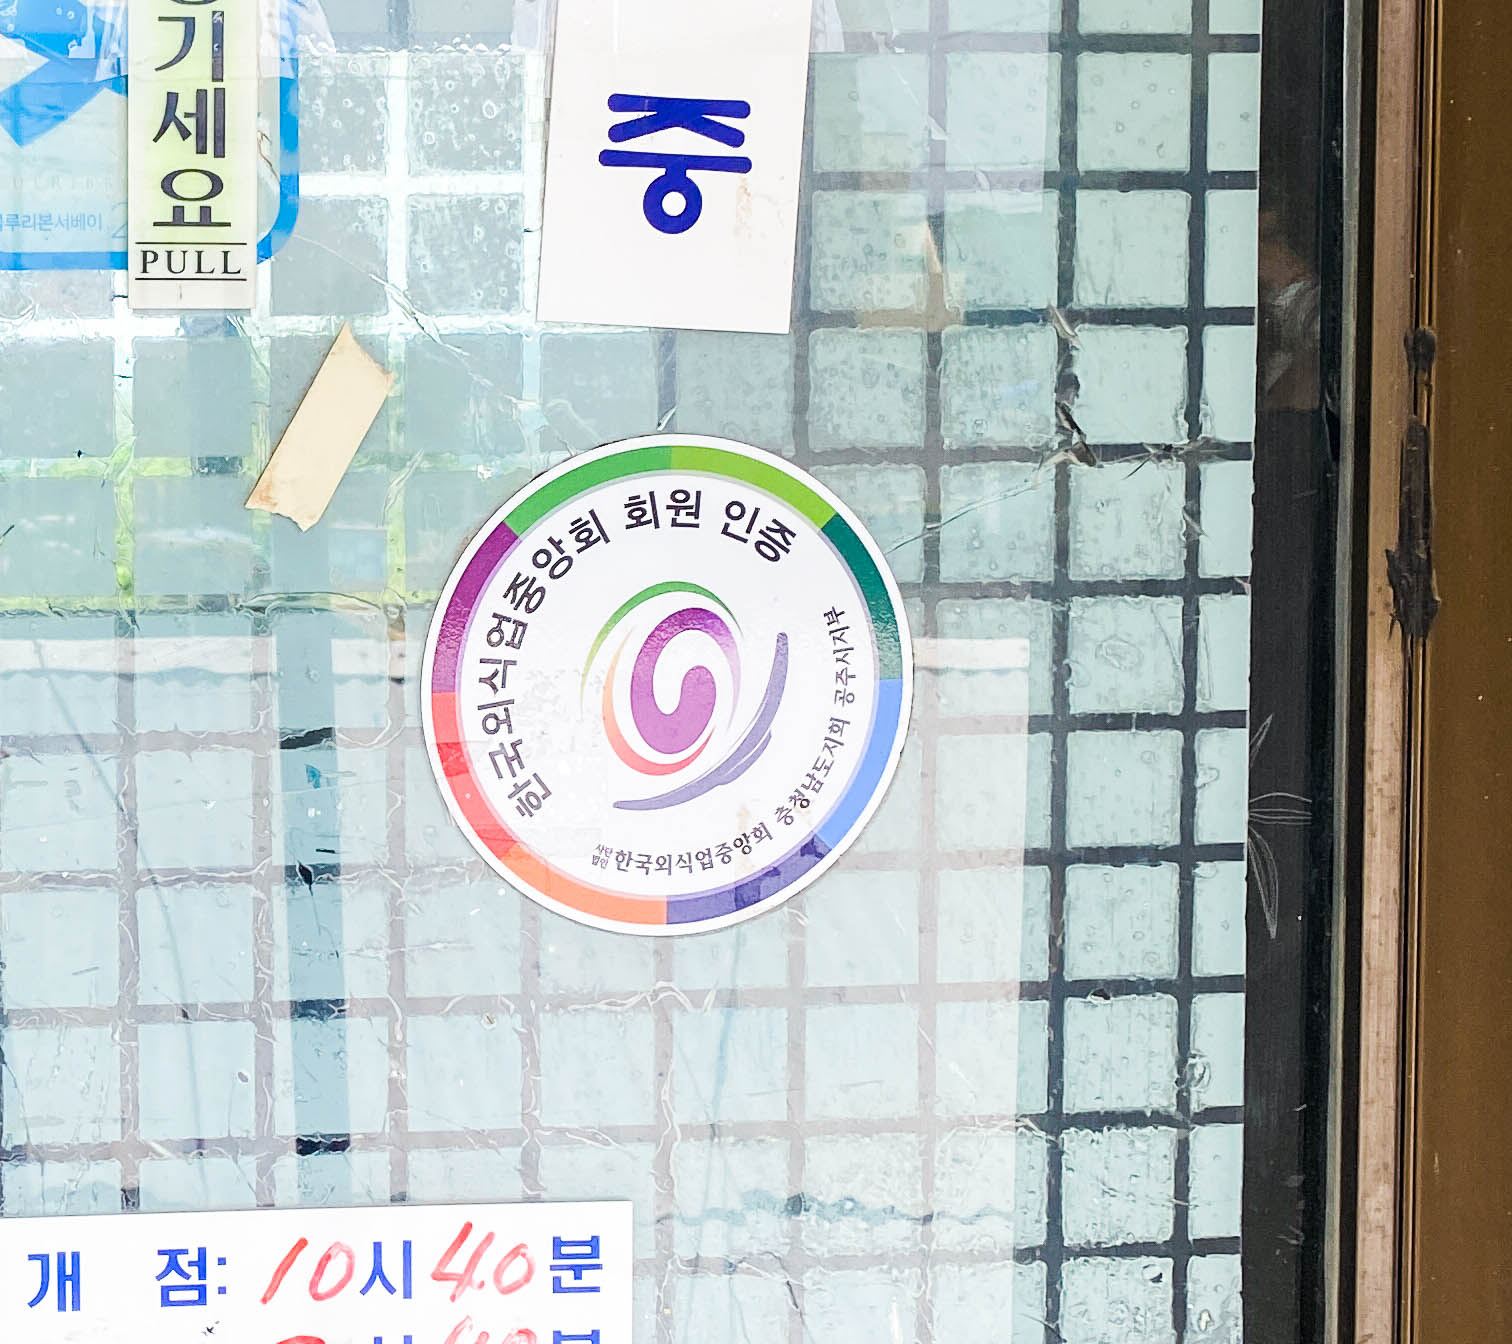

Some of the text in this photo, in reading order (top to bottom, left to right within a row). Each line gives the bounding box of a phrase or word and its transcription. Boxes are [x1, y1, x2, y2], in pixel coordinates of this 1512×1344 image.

[140, 249, 241, 275] PULL
[477, 487, 798, 818] 한국외식업중앙회 회원 인증
[615, 606, 856, 875] 한국외식업중앙회 충청남도지회 공주시지부
